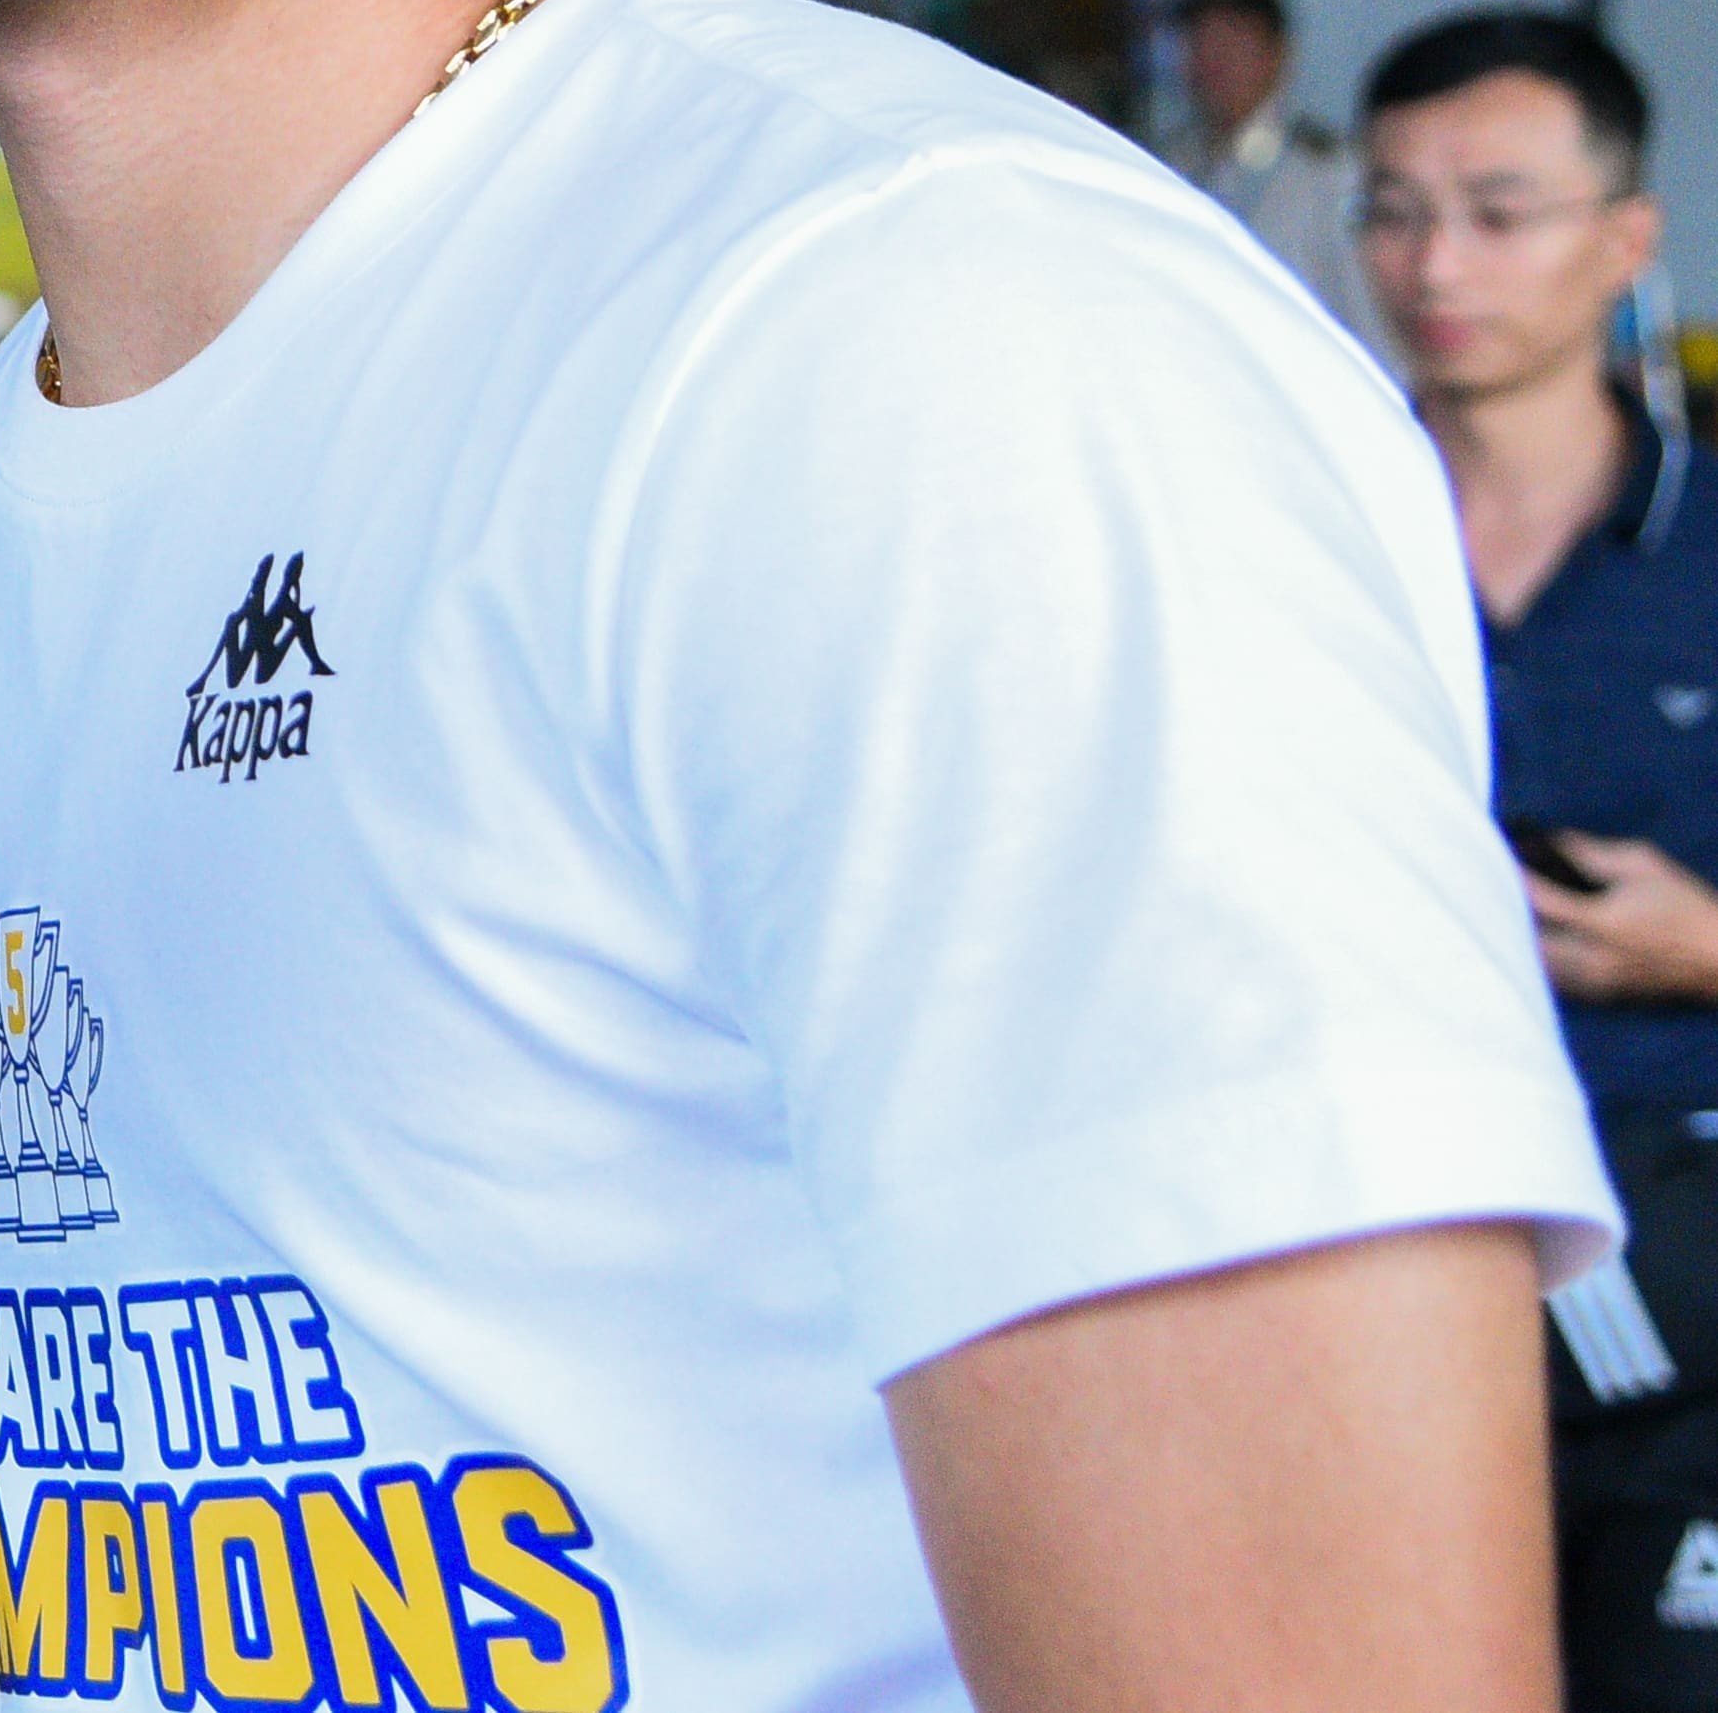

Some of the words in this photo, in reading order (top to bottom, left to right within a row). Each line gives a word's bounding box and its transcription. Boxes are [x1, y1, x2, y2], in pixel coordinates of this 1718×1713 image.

[172, 689, 314, 785] Kappa
[5, 930, 26, 1035] 5
[118, 1273, 366, 1470] THE
